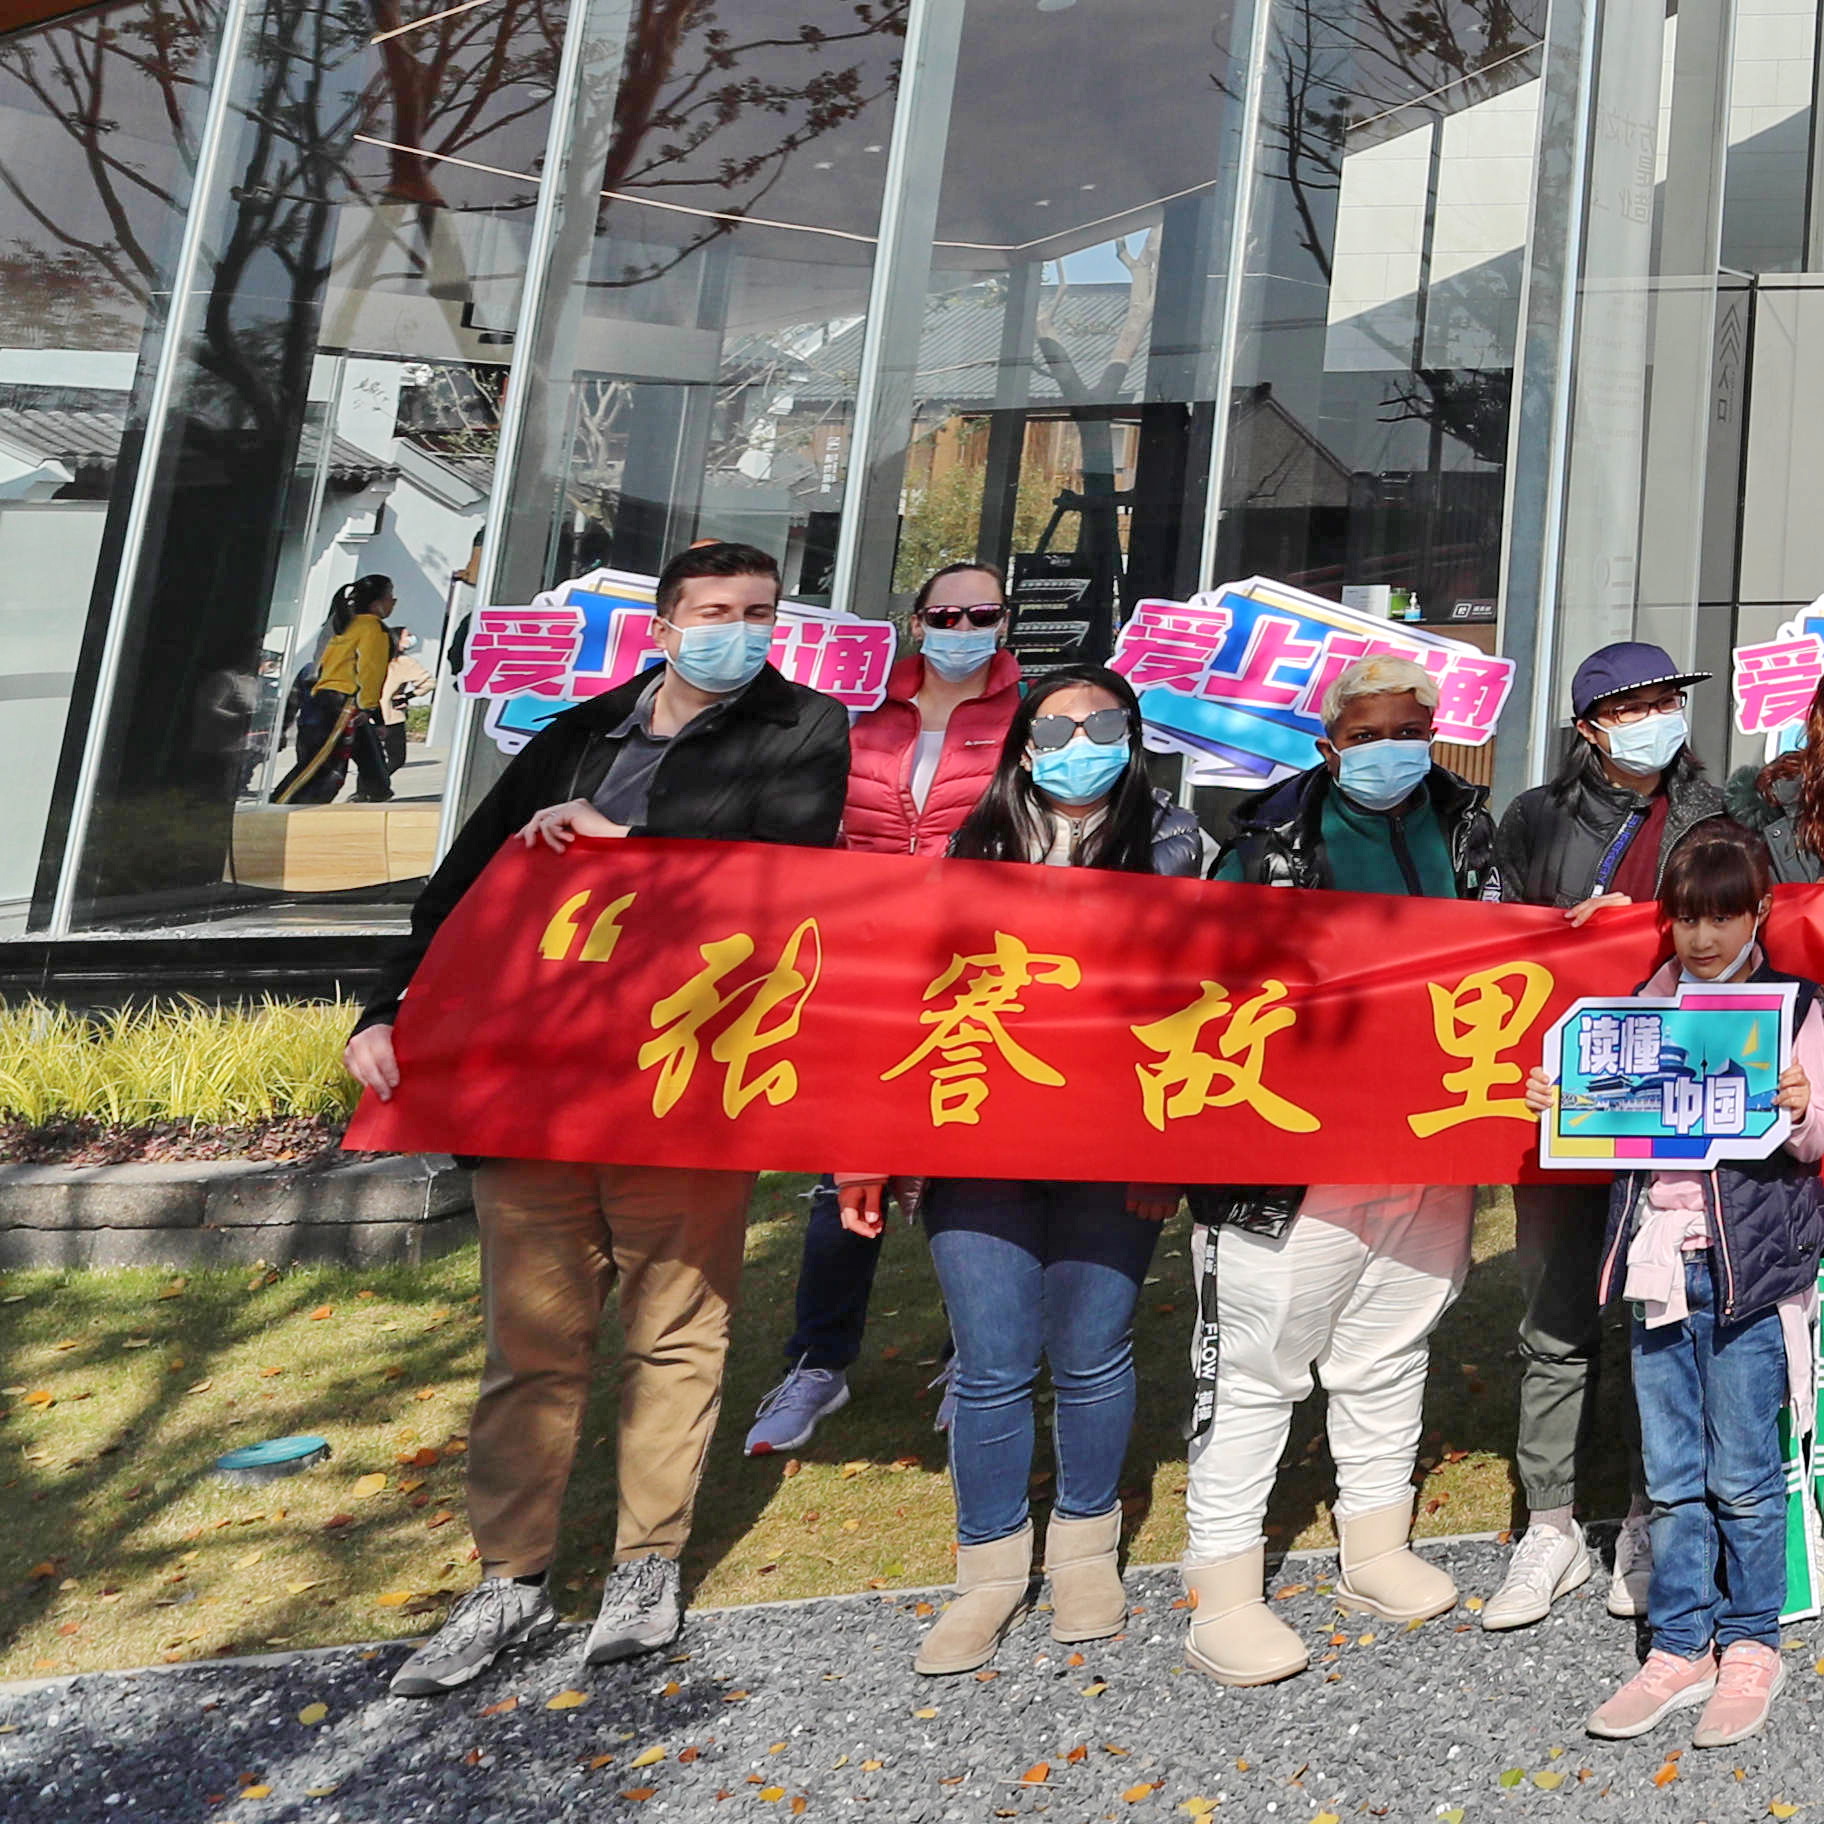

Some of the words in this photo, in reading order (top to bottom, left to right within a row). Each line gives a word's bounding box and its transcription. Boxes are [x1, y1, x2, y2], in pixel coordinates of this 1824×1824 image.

[464, 610, 891, 707] 爱上通
[1579, 1014, 1663, 1075] 读懂
[1662, 1075, 1747, 1136] 中国
[1201, 1322, 1218, 1380] FLOW
